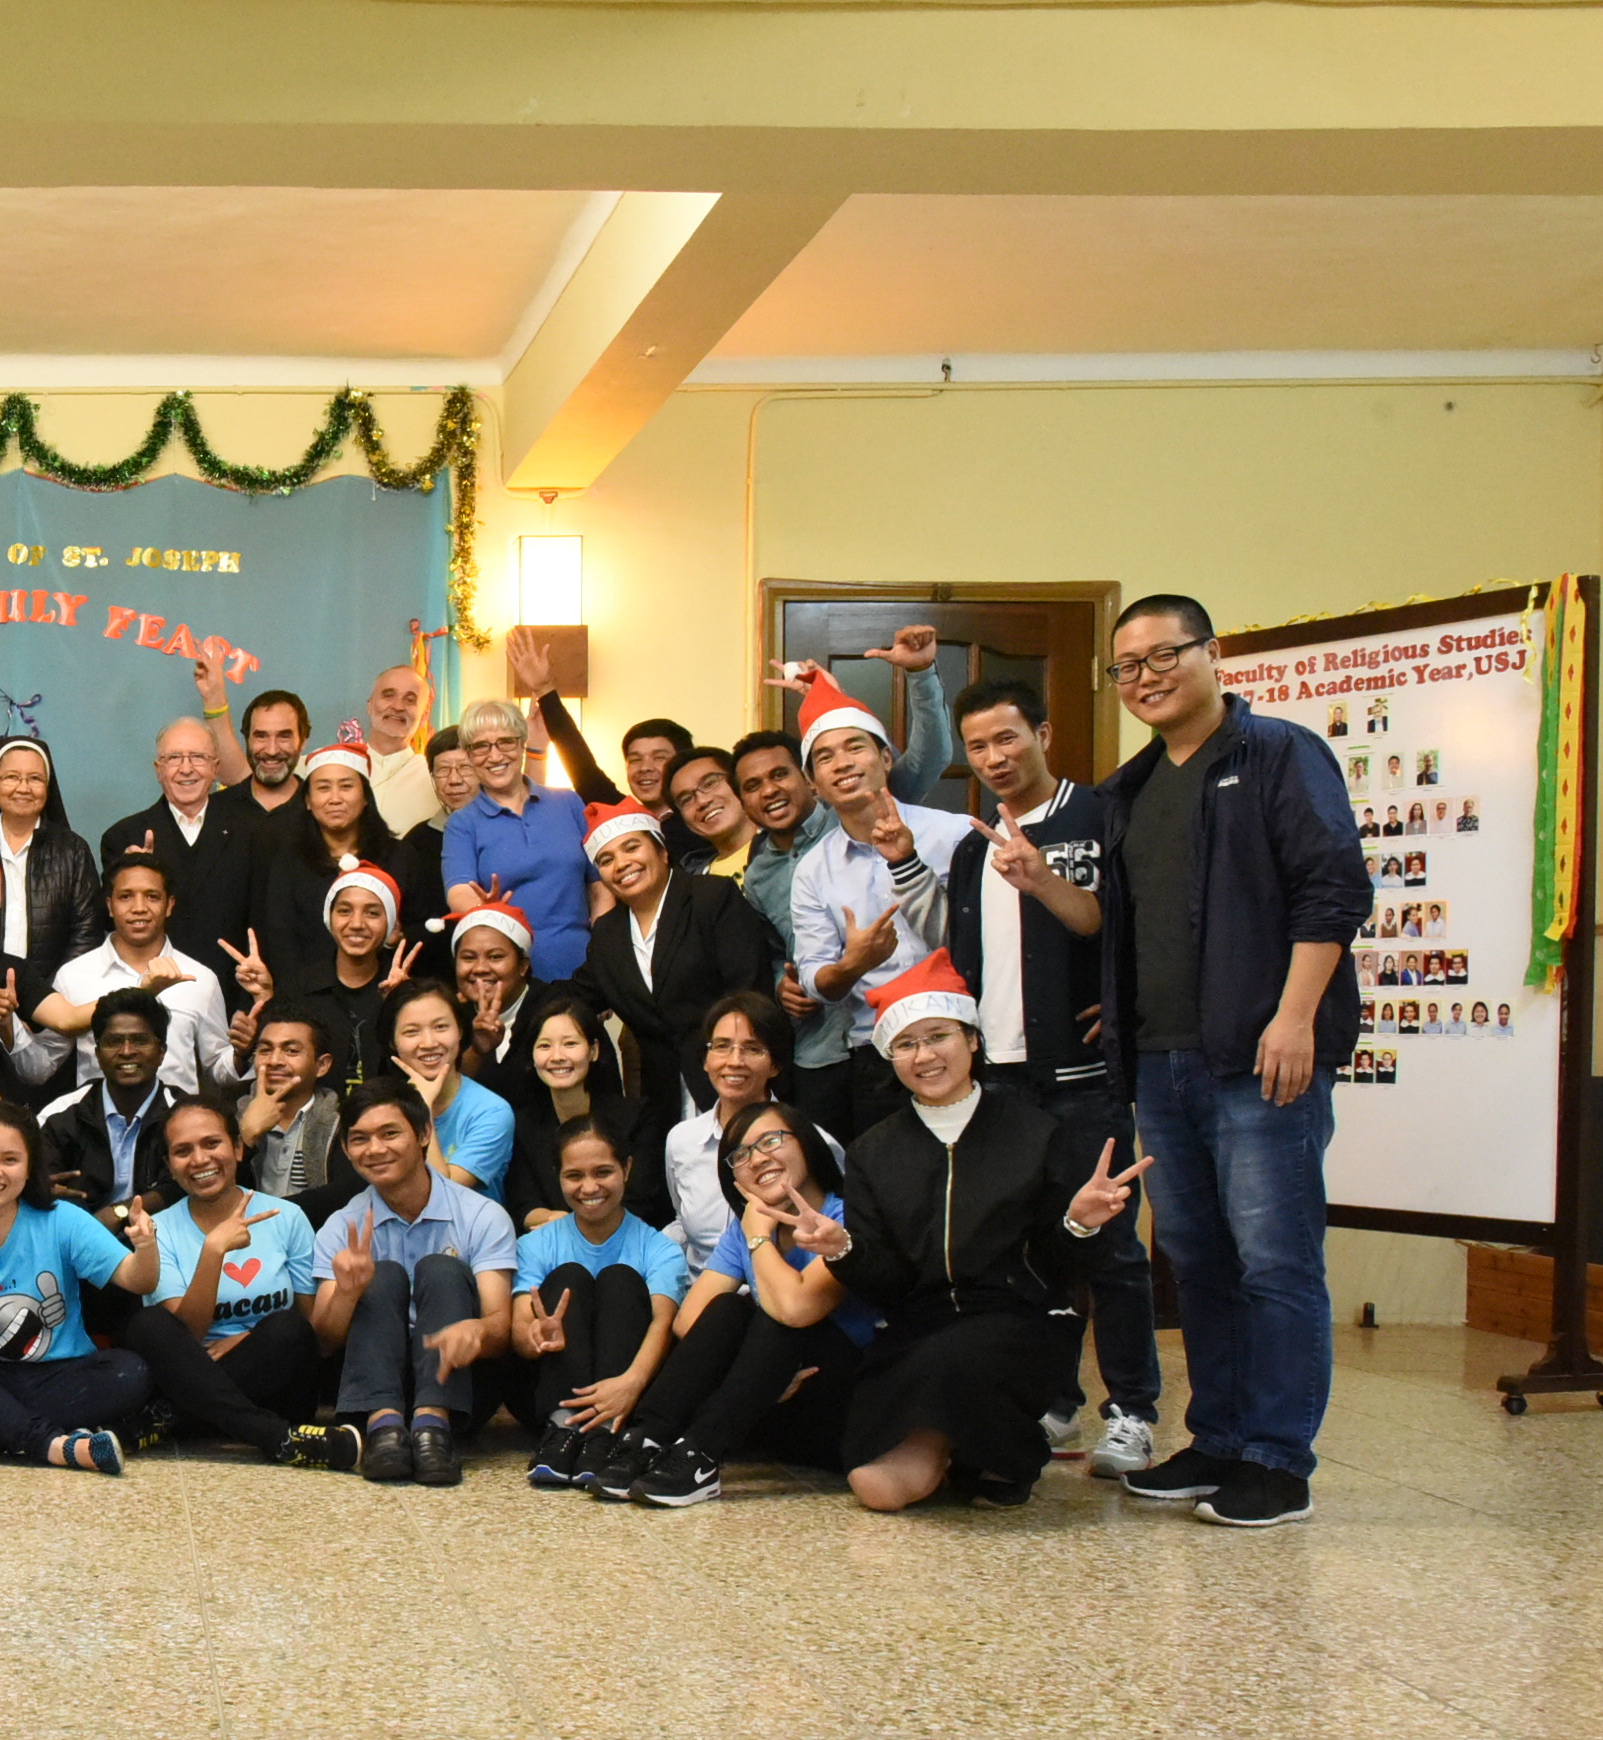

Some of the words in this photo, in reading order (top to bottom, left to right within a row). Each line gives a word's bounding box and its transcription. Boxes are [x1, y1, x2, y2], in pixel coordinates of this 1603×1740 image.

[7, 543, 47, 566] OF
[62, 546, 109, 568] ST.
[125, 546, 242, 573] JOSEPH
[1295, 656, 1318, 676] of
[1323, 643, 1431, 672] Religious
[1296, 668, 1408, 701] Academic
[213, 1287, 289, 1320] acau
